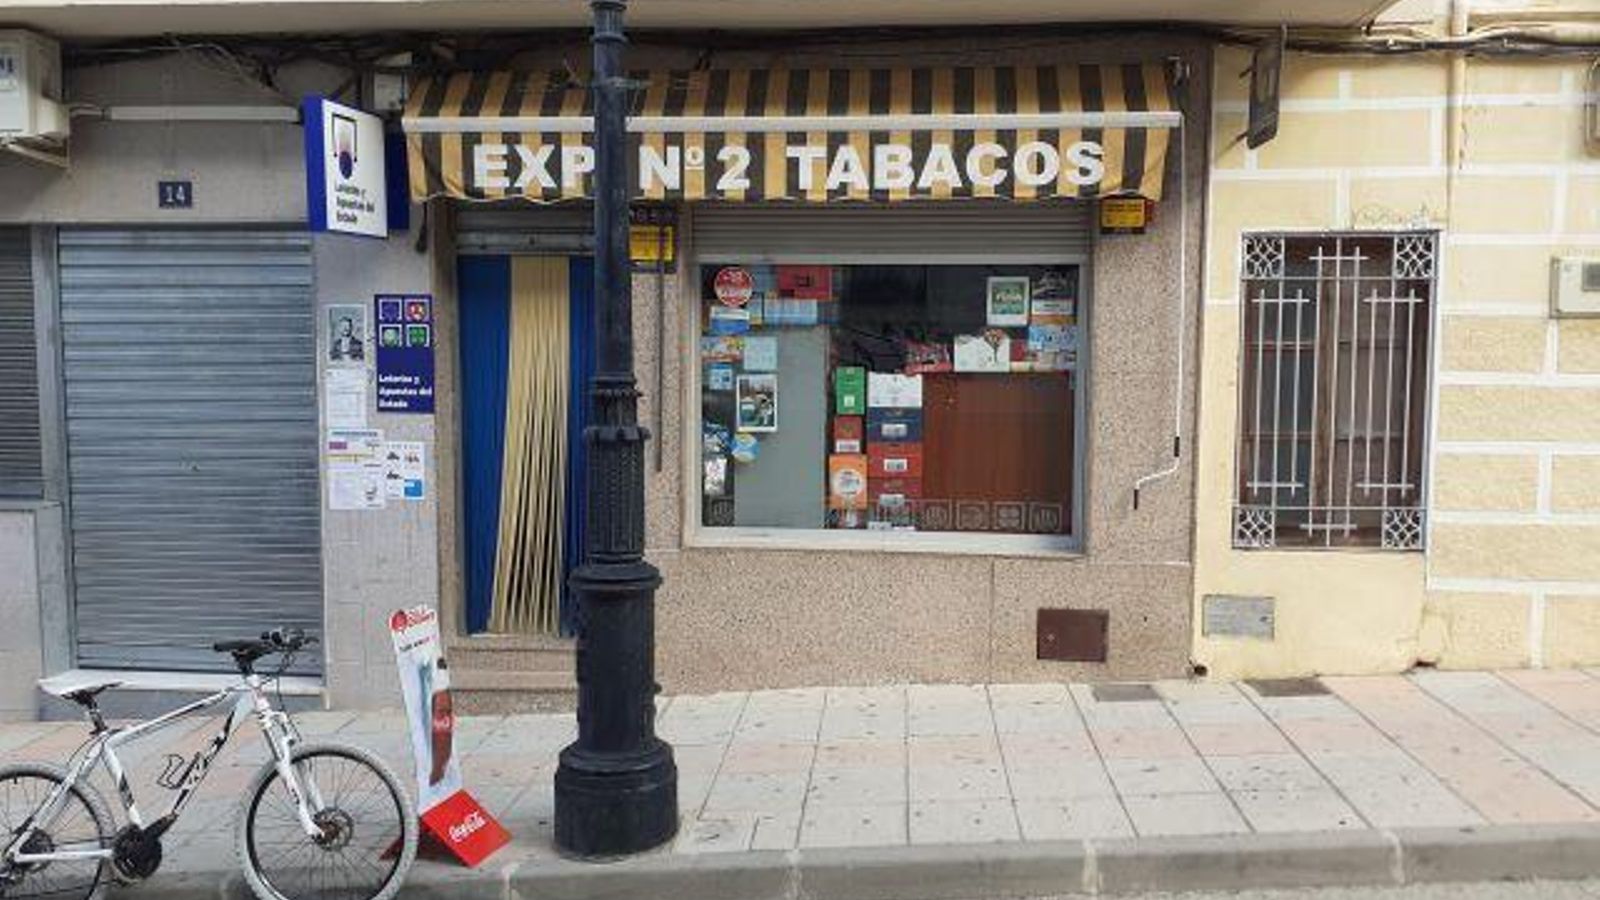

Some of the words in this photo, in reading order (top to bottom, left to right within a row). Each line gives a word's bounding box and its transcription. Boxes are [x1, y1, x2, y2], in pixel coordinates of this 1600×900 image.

[715, 145, 751, 190] 2
[786, 141, 1105, 190] TABACOS
[165, 185, 185, 204] 14
